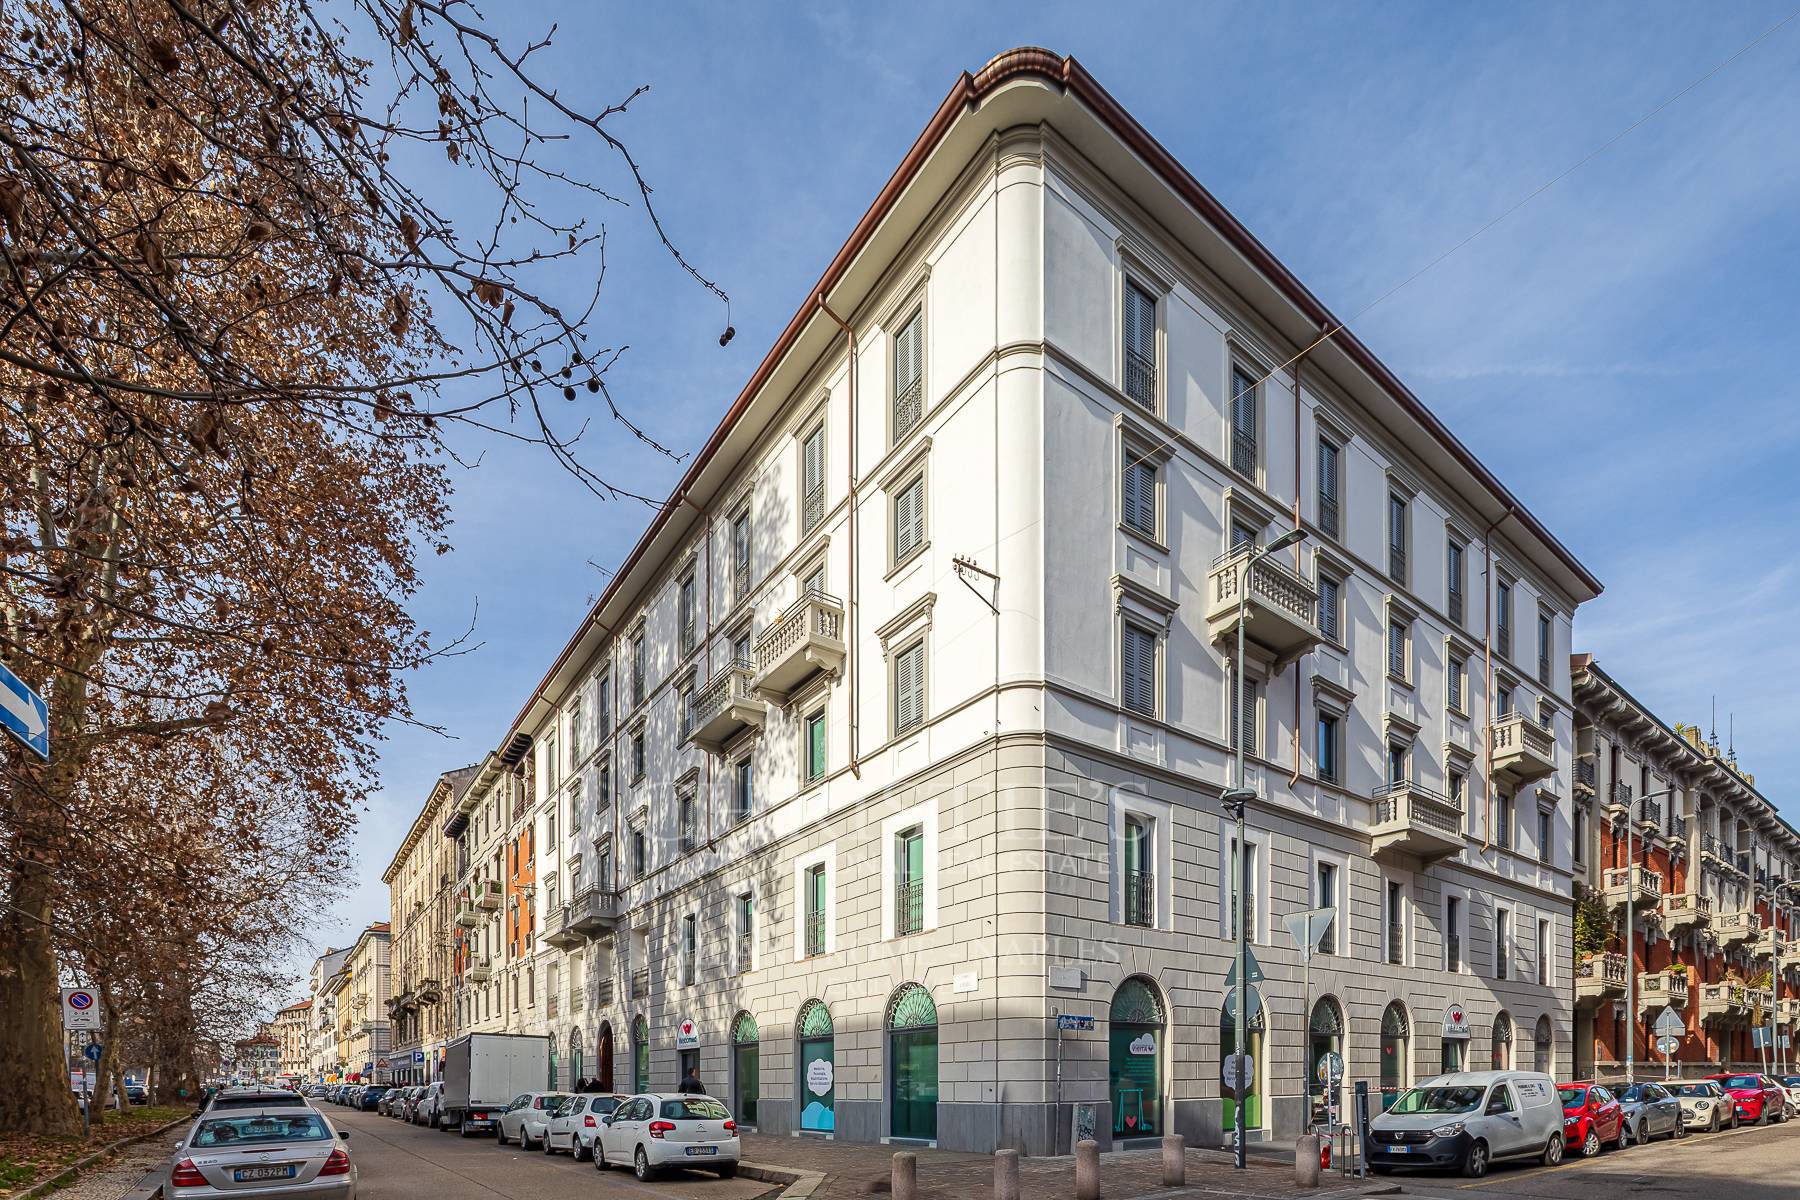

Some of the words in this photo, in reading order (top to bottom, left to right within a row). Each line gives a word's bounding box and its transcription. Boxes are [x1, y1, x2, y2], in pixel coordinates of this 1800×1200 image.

[415, 1052, 423, 1061] P
[242, 1169, 254, 1179] CZ
[257, 1166, 288, 1178] 032PM
